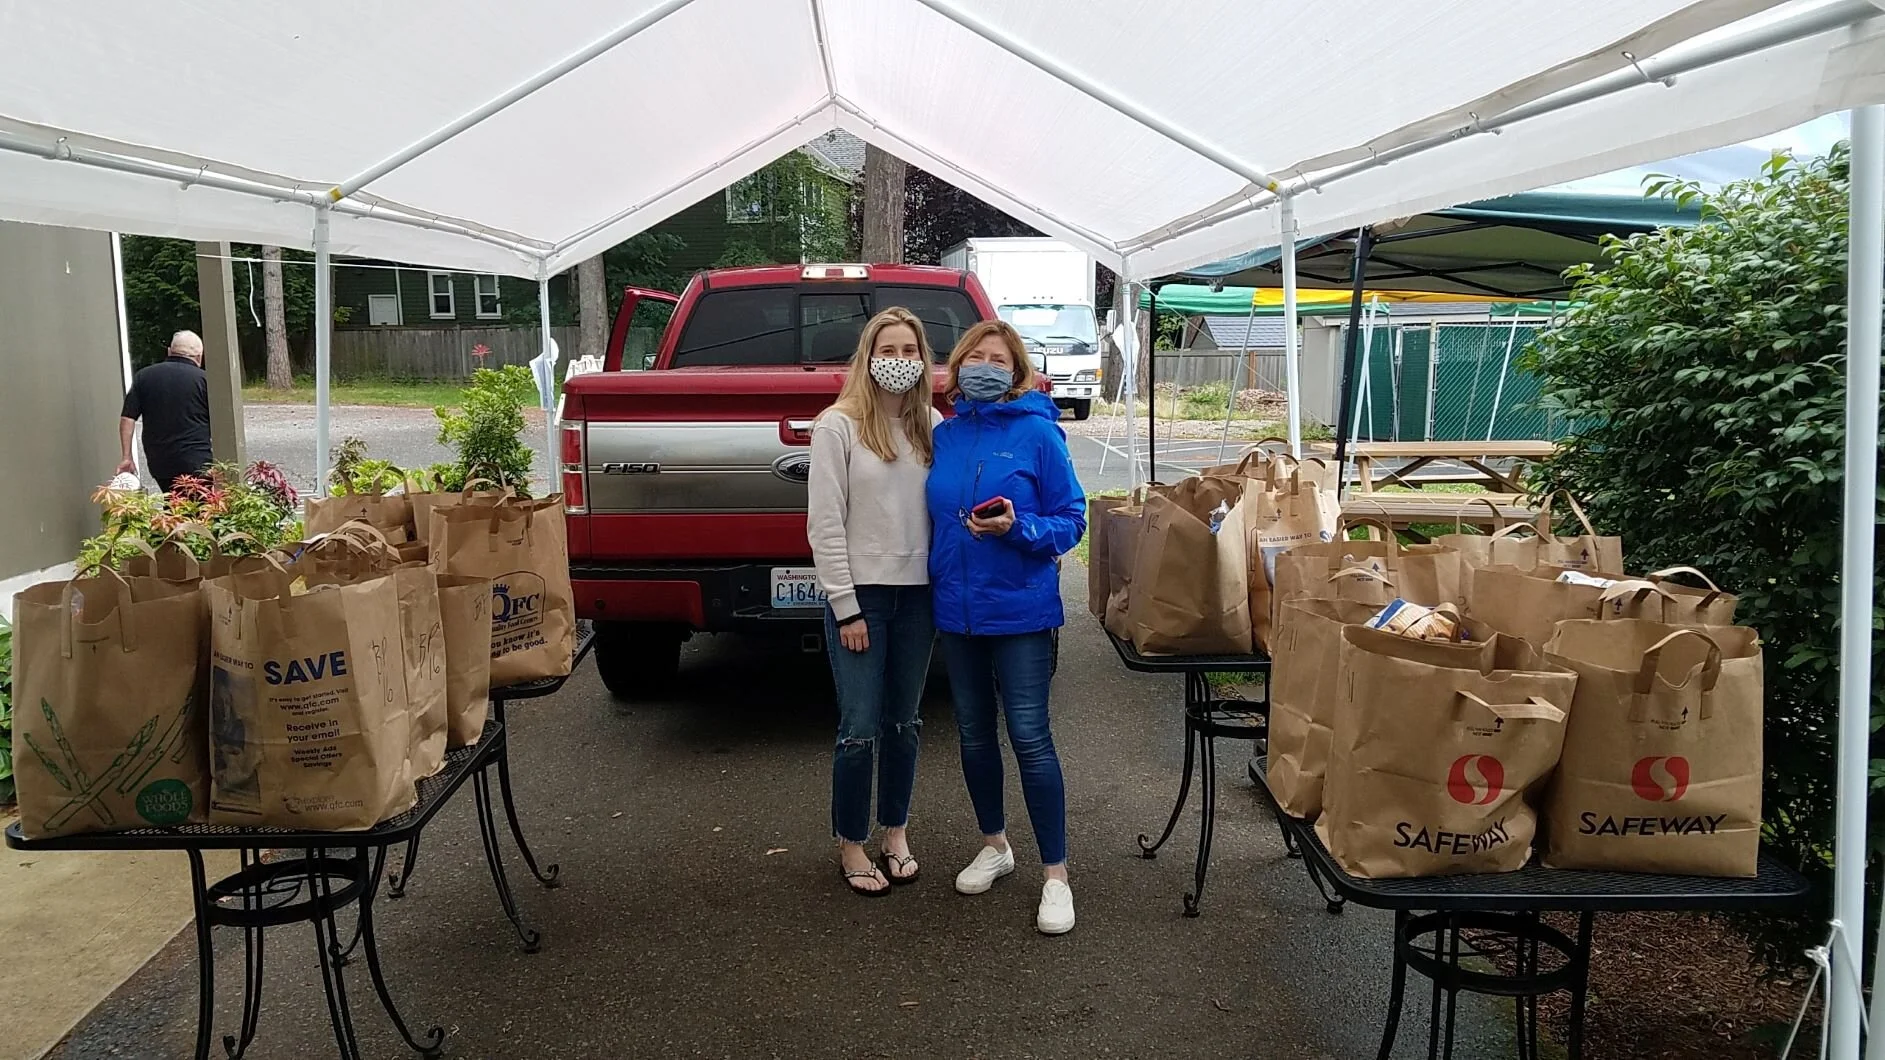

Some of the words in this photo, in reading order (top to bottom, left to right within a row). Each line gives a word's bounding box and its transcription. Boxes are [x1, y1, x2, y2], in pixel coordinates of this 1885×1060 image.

[603, 463, 660, 475] F-150
[492, 622, 507, 634] uality
[491, 641, 502, 650] ou
[503, 634, 526, 648] know
[502, 647, 511, 656] to
[512, 642, 523, 652] be
[525, 637, 548, 651] good.
[263, 650, 347, 686] SAVE
[286, 722, 327, 733] Receive
[287, 734, 309, 744] your
[311, 728, 340, 740] email
[1578, 811, 1728, 836] SAFEWAY
[1393, 815, 1511, 855] SAFEWAY
